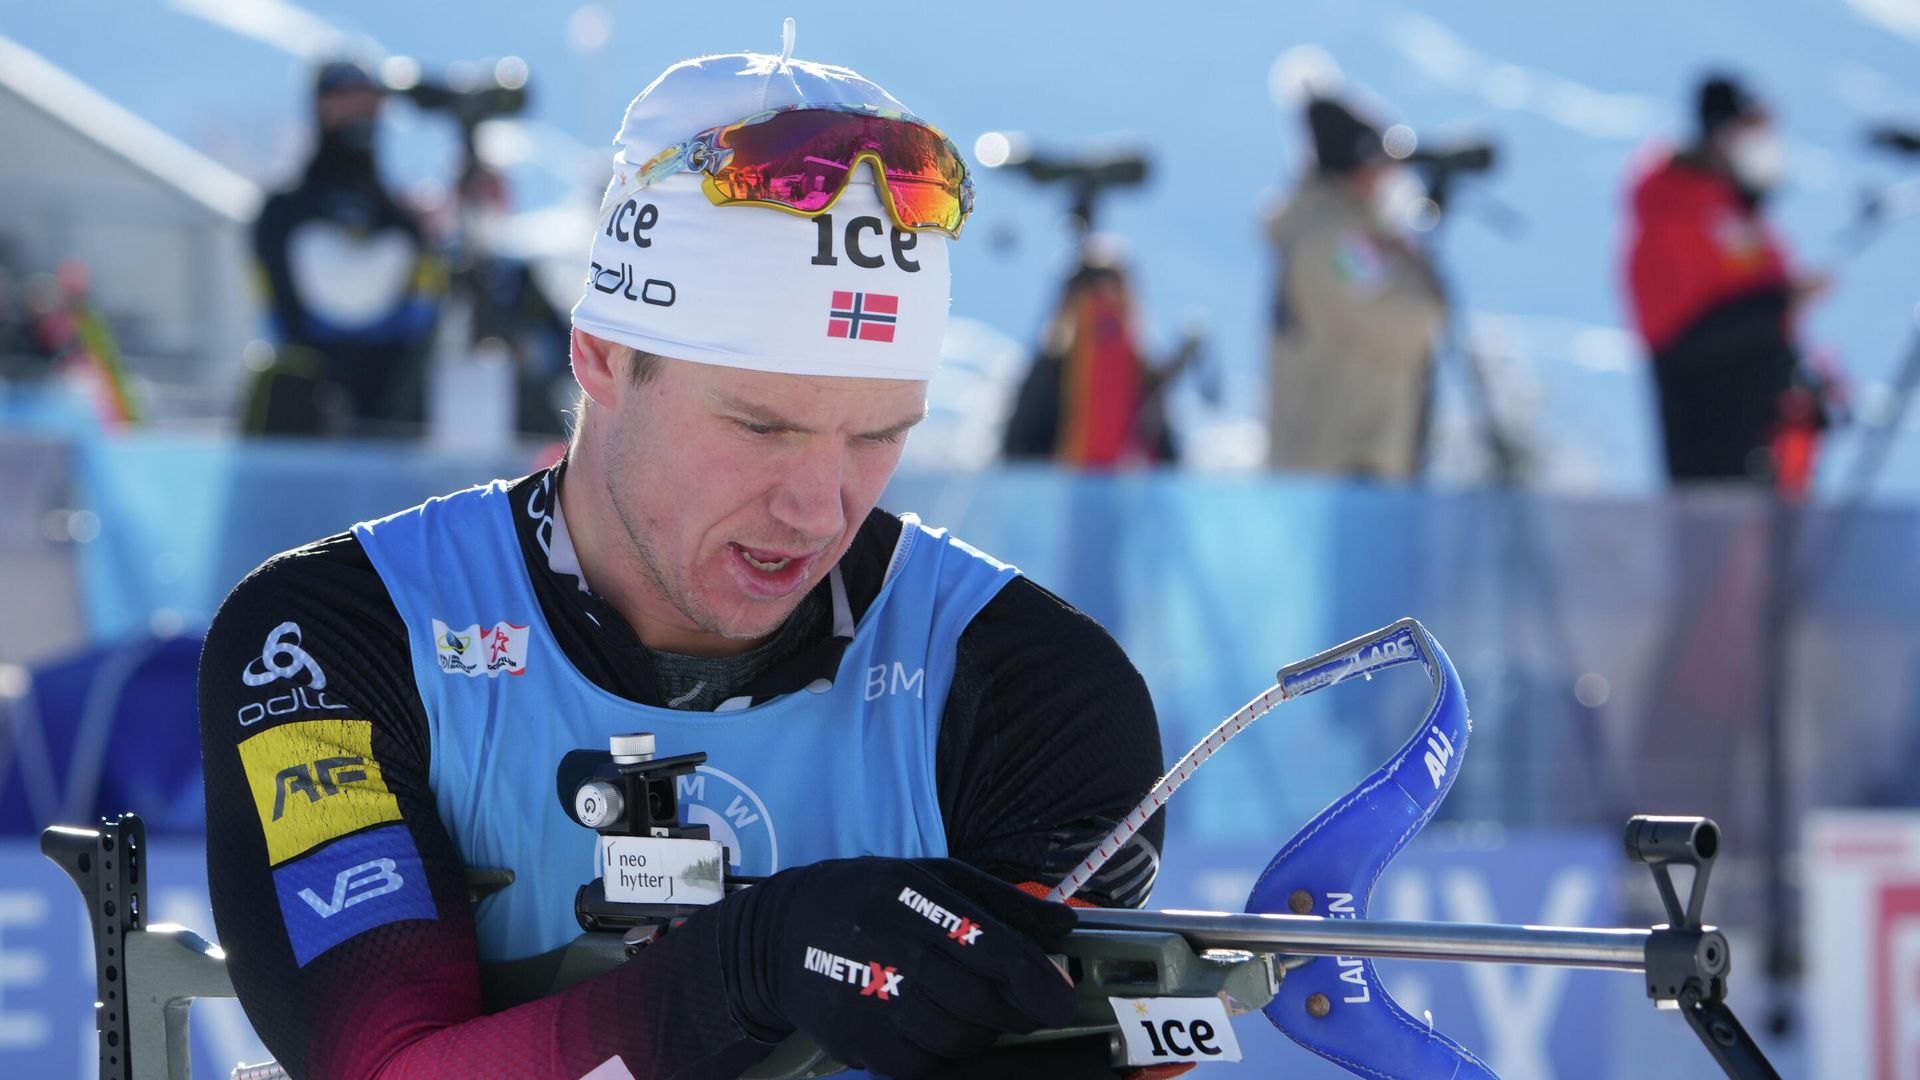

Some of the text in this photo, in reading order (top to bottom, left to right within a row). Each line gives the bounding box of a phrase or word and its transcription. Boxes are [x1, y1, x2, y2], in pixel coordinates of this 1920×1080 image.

[811, 214, 921, 272] ice
[864, 661, 924, 701] BM
[676, 775, 760, 829] MW
[619, 853, 647, 867] neo
[620, 869, 664, 891] hytter
[297, 857, 405, 918] VB
[1140, 1018, 1222, 1057] ice
